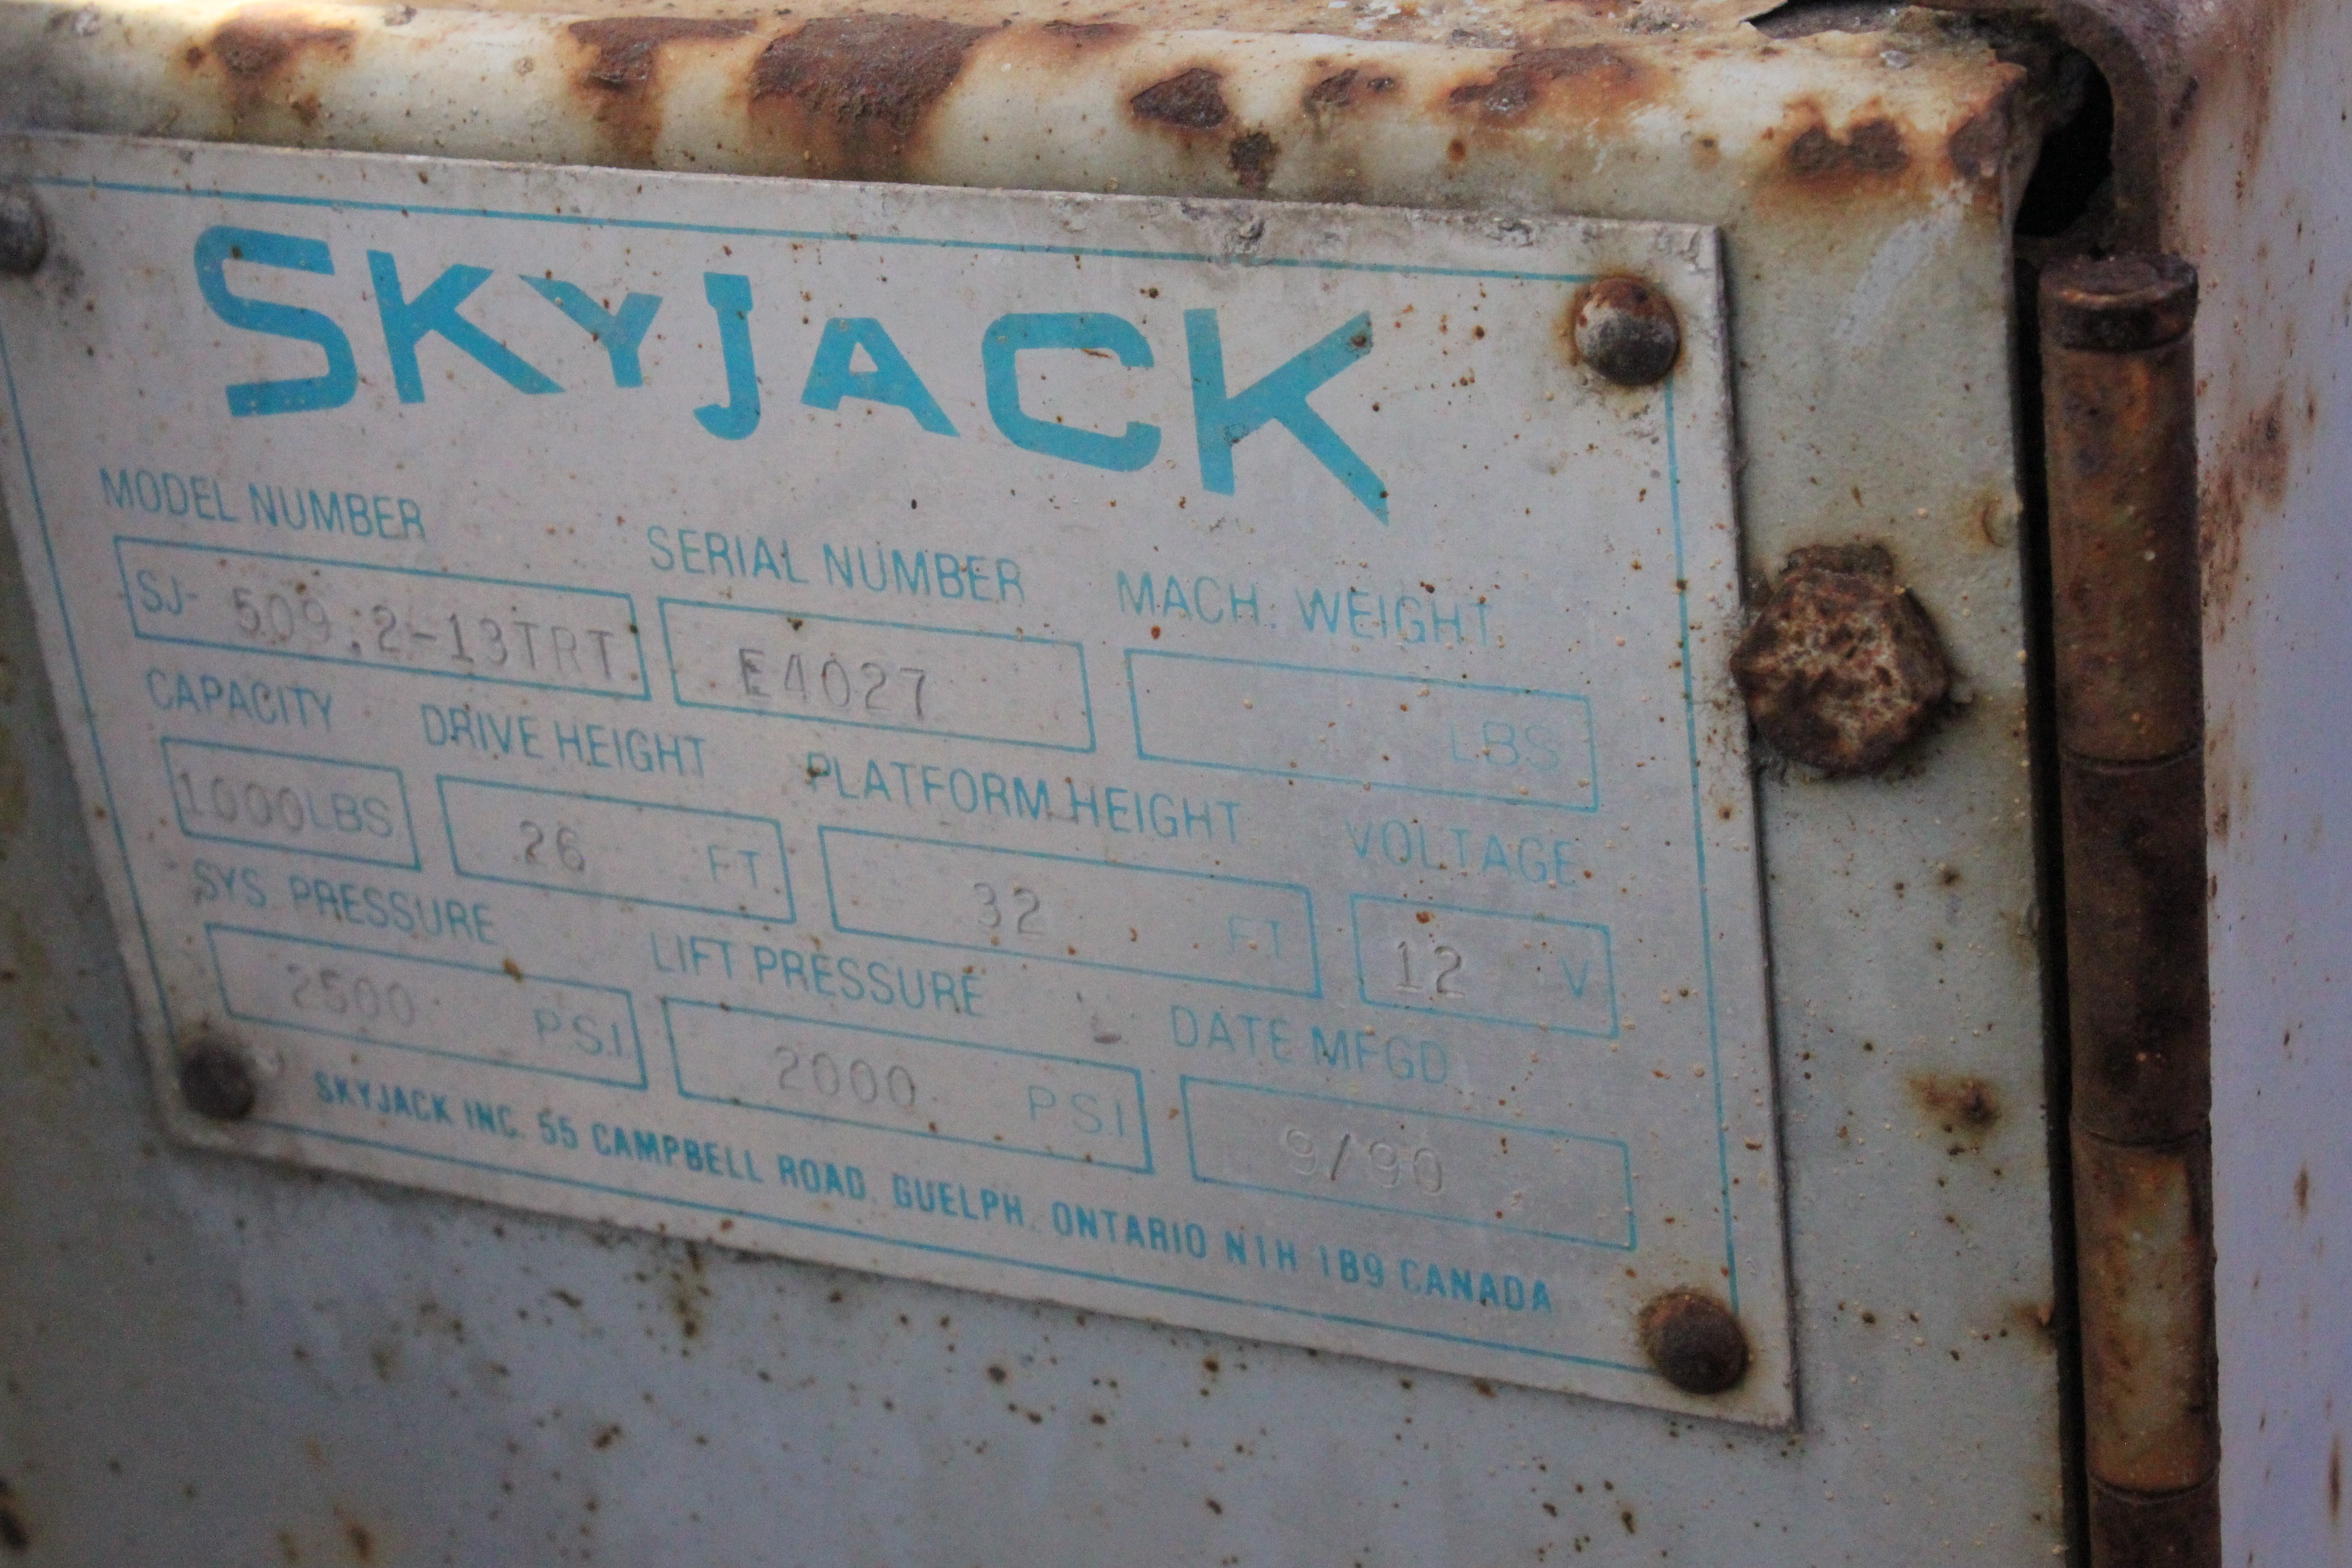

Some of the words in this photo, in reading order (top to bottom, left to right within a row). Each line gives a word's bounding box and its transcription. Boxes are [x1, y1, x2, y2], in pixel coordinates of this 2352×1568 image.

[198, 225, 1389, 527] SKYJACK
[100, 468, 237, 523] MODEL
[250, 483, 426, 541] NUMBER
[647, 525, 809, 584] SERIAL
[823, 543, 1025, 602] NUMBER
[1294, 587, 1492, 647] WEIGHT
[147, 669, 333, 733] CAPACITY
[737, 647, 928, 719] E4027
[420, 703, 544, 758] DRIVE
[554, 723, 707, 779] HEIGHT
[1450, 720, 1561, 773] LBS
[806, 751, 1051, 822] PLATFORM
[1070, 784, 1243, 845] HEIGHT
[518, 818, 586, 872] 26
[708, 844, 760, 890] FT
[1345, 817, 1579, 887] VOLTAGE
[288, 873, 500, 946] PRESSURE
[972, 881, 1044, 937] 32
[1226, 913, 1284, 960] FT
[649, 931, 736, 982] LIFT
[754, 943, 987, 1018] PRESSURE
[1396, 940, 1465, 999] 12
[1559, 957, 1590, 999] V
[287, 962, 416, 1028] 2500
[533, 1008, 624, 1057] PSI
[1169, 1003, 1293, 1064] DATE
[1311, 1025, 1449, 1086] MFGD
[773, 1046, 918, 1110] 2000
[1027, 1084, 1126, 1138] PSI
[312, 1069, 453, 1124] SKYJACK
[537, 1112, 580, 1150] 55
[592, 1123, 766, 1185] CAMPBELL
[1051, 1201, 1207, 1259] ONTARIO
[1400, 1258, 1553, 1315] CANADA
[1281, 1127, 1445, 1195] 9/90
